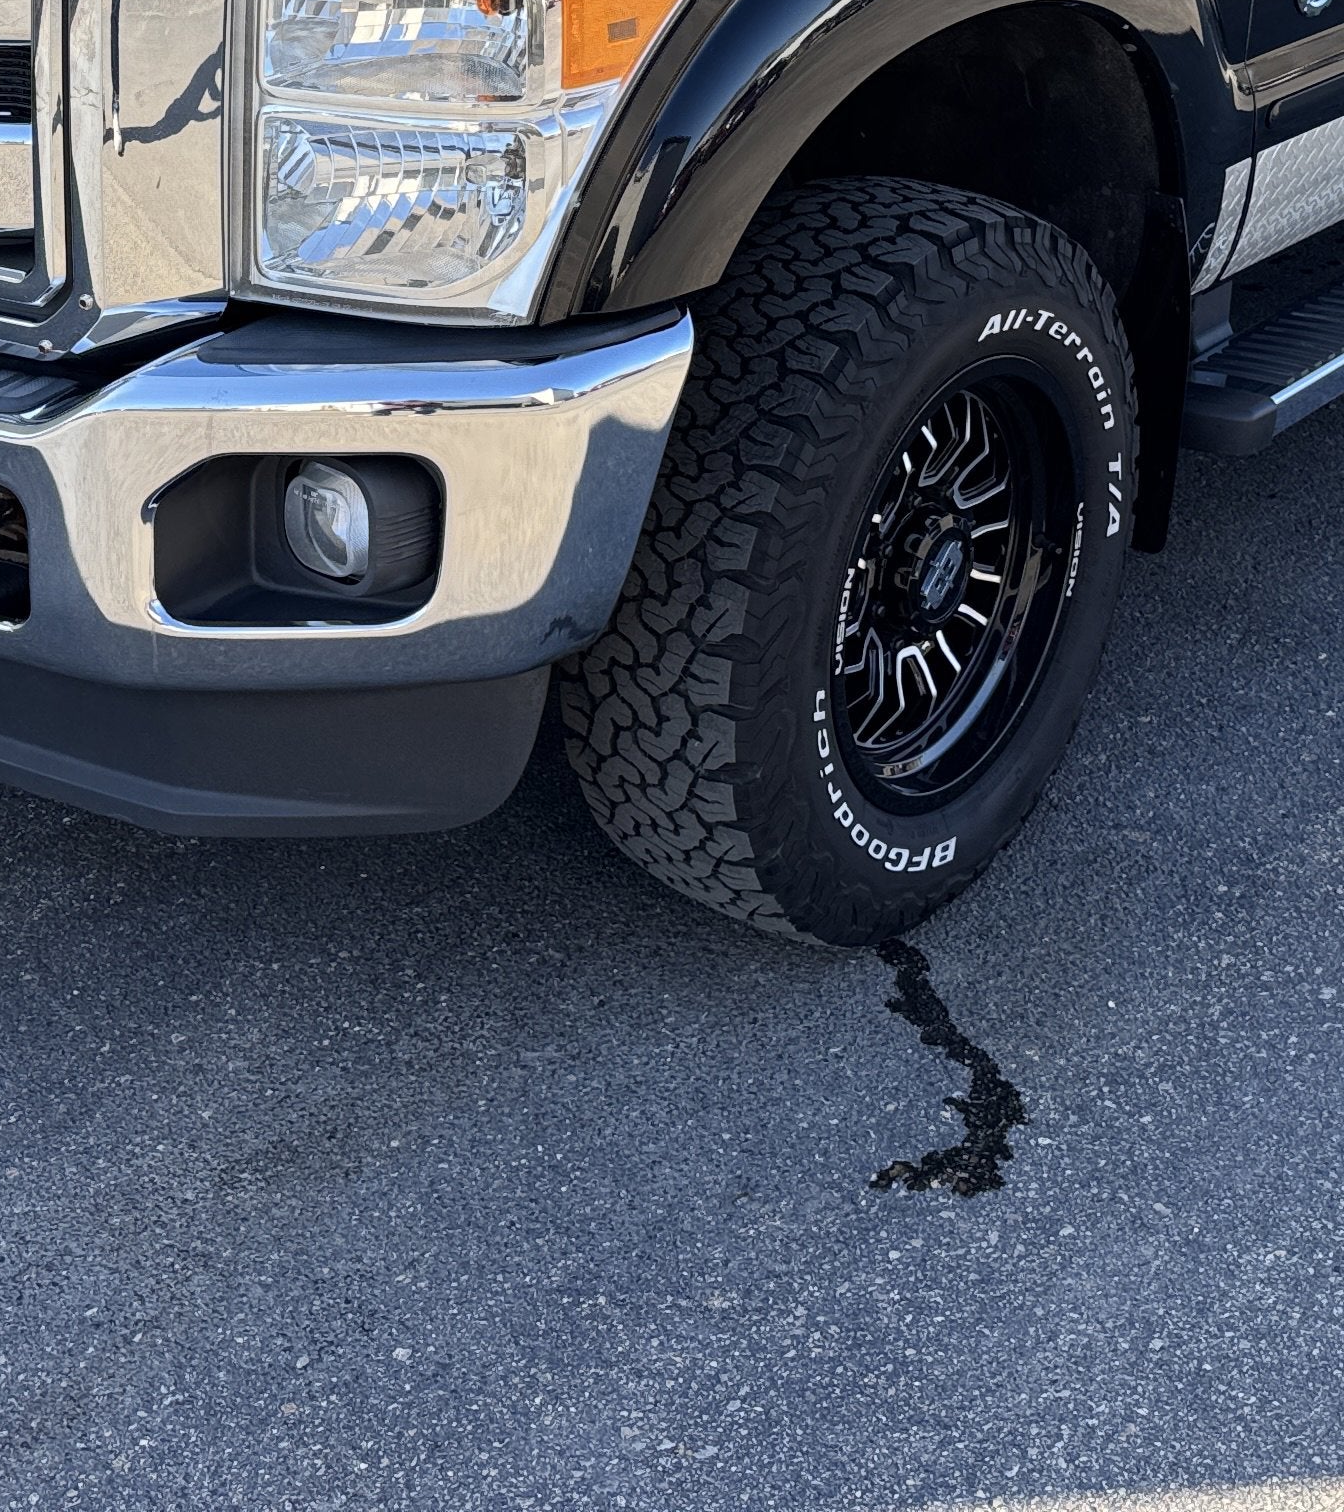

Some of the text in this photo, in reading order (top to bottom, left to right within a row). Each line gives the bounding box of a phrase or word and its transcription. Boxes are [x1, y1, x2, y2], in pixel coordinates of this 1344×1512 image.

[977, 308, 1123, 538] All-Terrain T/A
[813, 689, 957, 872] BFGoodrich
